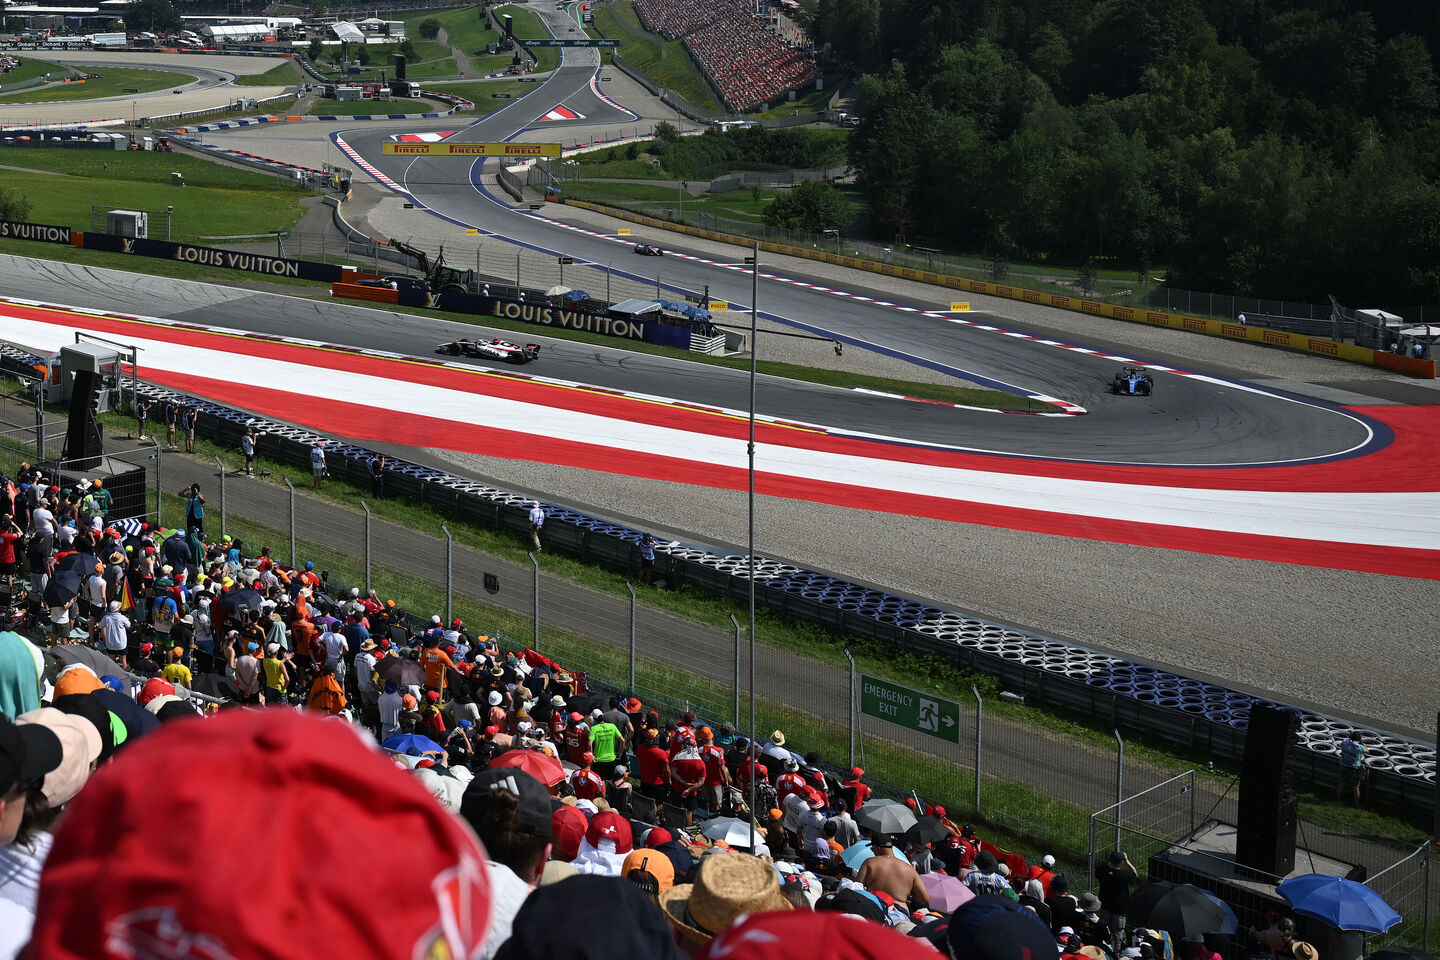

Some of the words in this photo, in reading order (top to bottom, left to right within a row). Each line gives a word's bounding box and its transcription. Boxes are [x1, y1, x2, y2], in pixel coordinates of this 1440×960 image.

[394, 145, 430, 154] PIRELLI
[450, 145, 486, 154] PIRELLI
[505, 145, 541, 154] PIRELLI
[12, 223, 70, 242] VUITTON
[177, 246, 222, 266] LOUIS
[228, 253, 299, 277] VUITTON
[496, 301, 552, 324] LOUIS
[559, 311, 644, 339] VUITTON
[1147, 312, 1168, 325] PIRELLI
[1183, 318, 1207, 331] PIRELLI
[1221, 324, 1247, 338] PIRELLI
[1263, 330, 1290, 345] PIRELLI
[1308, 339, 1337, 356] PIRELLI
[864, 683, 913, 707] EMERGENCY
[880, 702, 898, 717] EXIT
